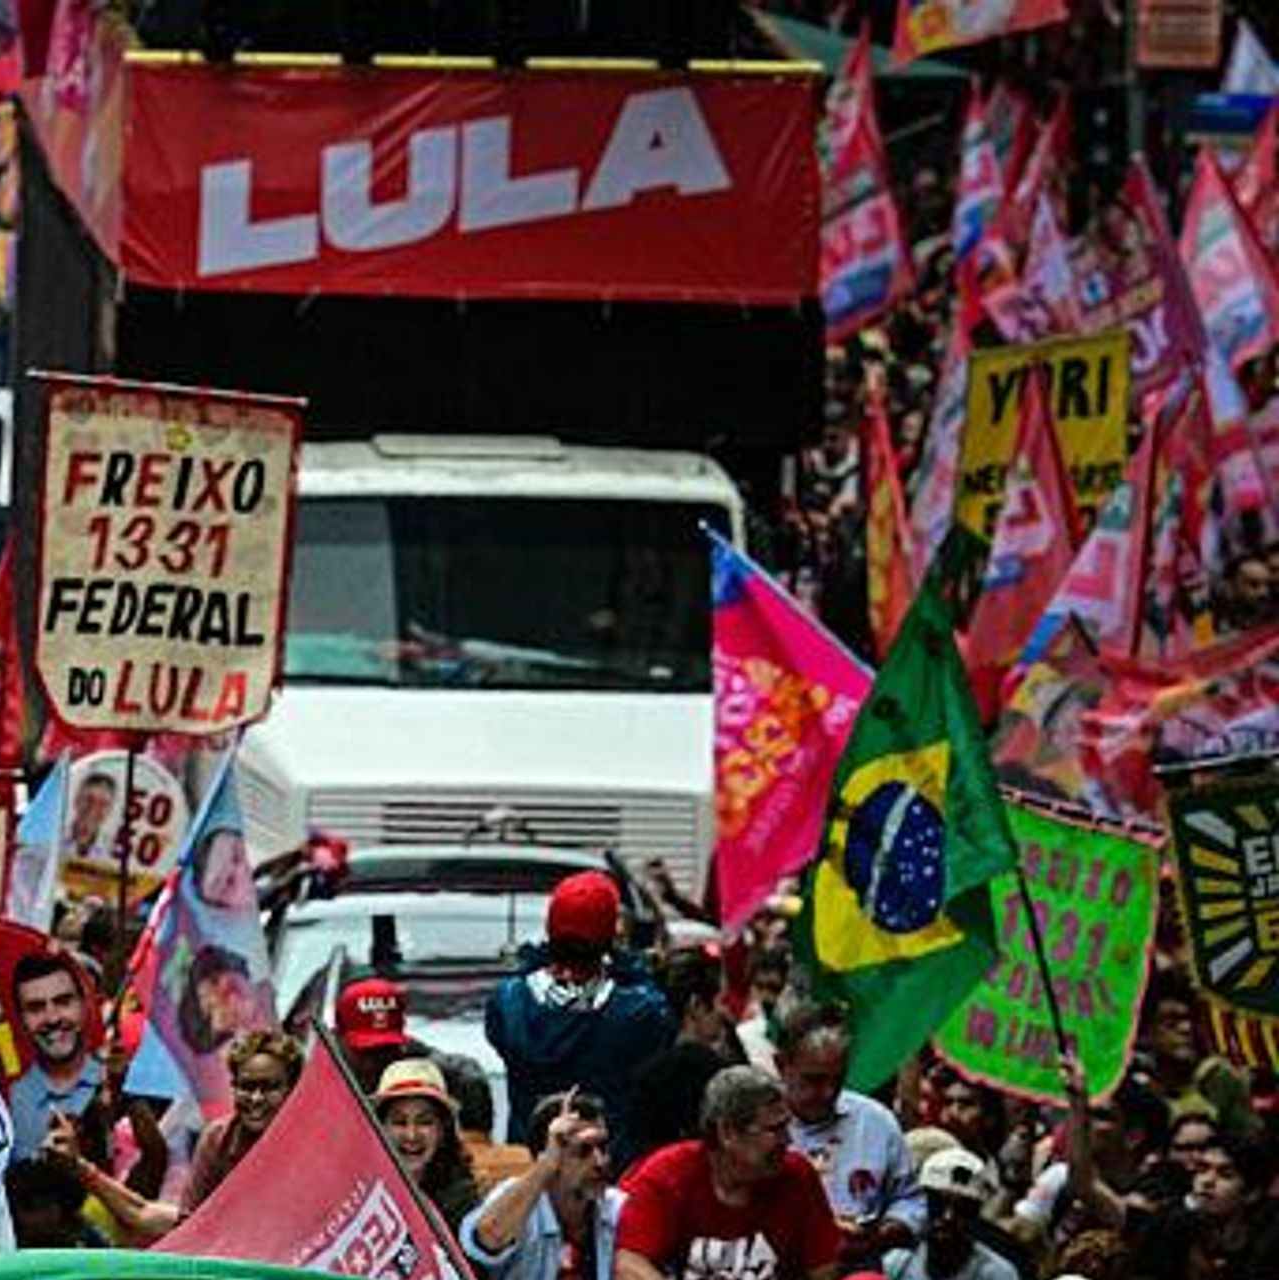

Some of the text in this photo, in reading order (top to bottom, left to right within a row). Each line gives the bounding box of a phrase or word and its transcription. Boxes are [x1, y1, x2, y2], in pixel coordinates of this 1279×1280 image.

[198, 87, 732, 277] LULA
[988, 355, 1112, 424] YRI
[63, 452, 266, 515] FREIXO
[88, 515, 231, 578] 1331
[45, 577, 266, 648] FEDERAL
[67, 660, 248, 722] DO LULA
